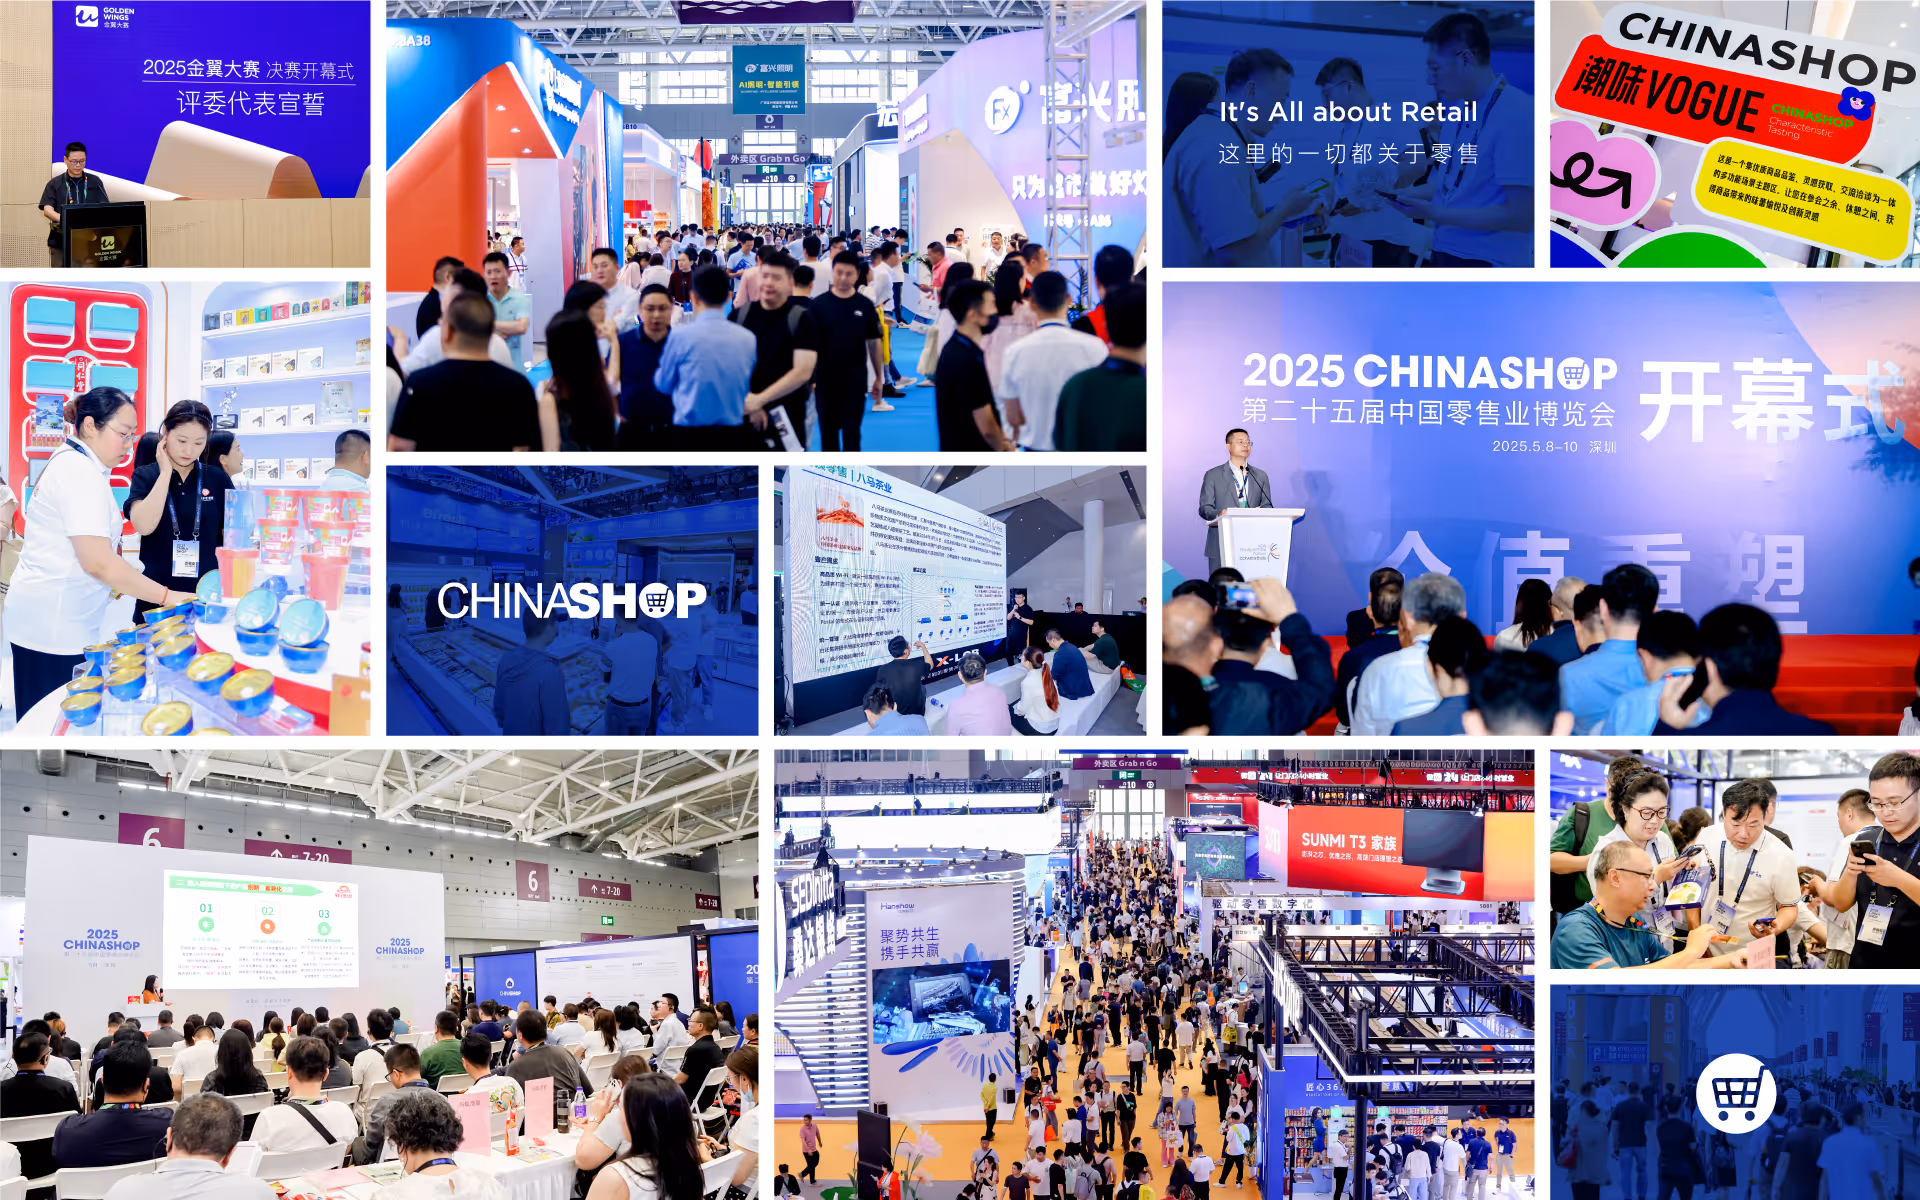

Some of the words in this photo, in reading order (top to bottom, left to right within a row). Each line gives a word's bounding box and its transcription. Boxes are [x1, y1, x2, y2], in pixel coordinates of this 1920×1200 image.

[1619, 12, 1917, 92] CHINASHOP
[144, 59, 261, 79] 2025金翼大赛
[266, 61, 354, 80] 决赛开幕式
[760, 64, 793, 72] 富兴照明
[177, 90, 325, 116] 评委代表宣誓
[1771, 103, 1854, 130] CHINASHOP
[1768, 125, 1800, 141] Tasting
[1769, 116, 1834, 138] Characteristic
[731, 154, 757, 164] 外卖区
[760, 155, 782, 163] Grab
[793, 155, 806, 163] Go
[1244, 352, 1345, 388] 2025
[1354, 354, 1618, 390] CHINASHOP
[1640, 357, 1906, 446] 开幕式
[1241, 396, 1616, 428] 第二十五届中国零售业博览会
[1589, 440, 1617, 454] 深圳
[856, 472, 892, 493] 八马茶业
[1094, 760, 1117, 768] 外卖区
[142, 827, 162, 848] 6
[1302, 832, 1345, 848] SUNMI
[1350, 834, 1366, 849] T3
[1371, 835, 1396, 851] 家族
[303, 852, 330, 864] 7-20
[528, 870, 538, 892] 6
[606, 886, 621, 896] 7-20
[199, 903, 213, 913] 01
[261, 906, 274, 916] 02
[1212, 898, 1312, 909] 驱动零售数字化
[318, 910, 330, 918] 03
[87, 929, 119, 939] 2025
[880, 926, 939, 944] 聚势共生
[63, 940, 140, 950] CHINASHOP
[390, 938, 411, 946] 2025
[376, 946, 425, 955] CHINASHOP
[880, 943, 939, 961] 携手共赢
[1306, 1083, 1343, 1092] 匠心36
